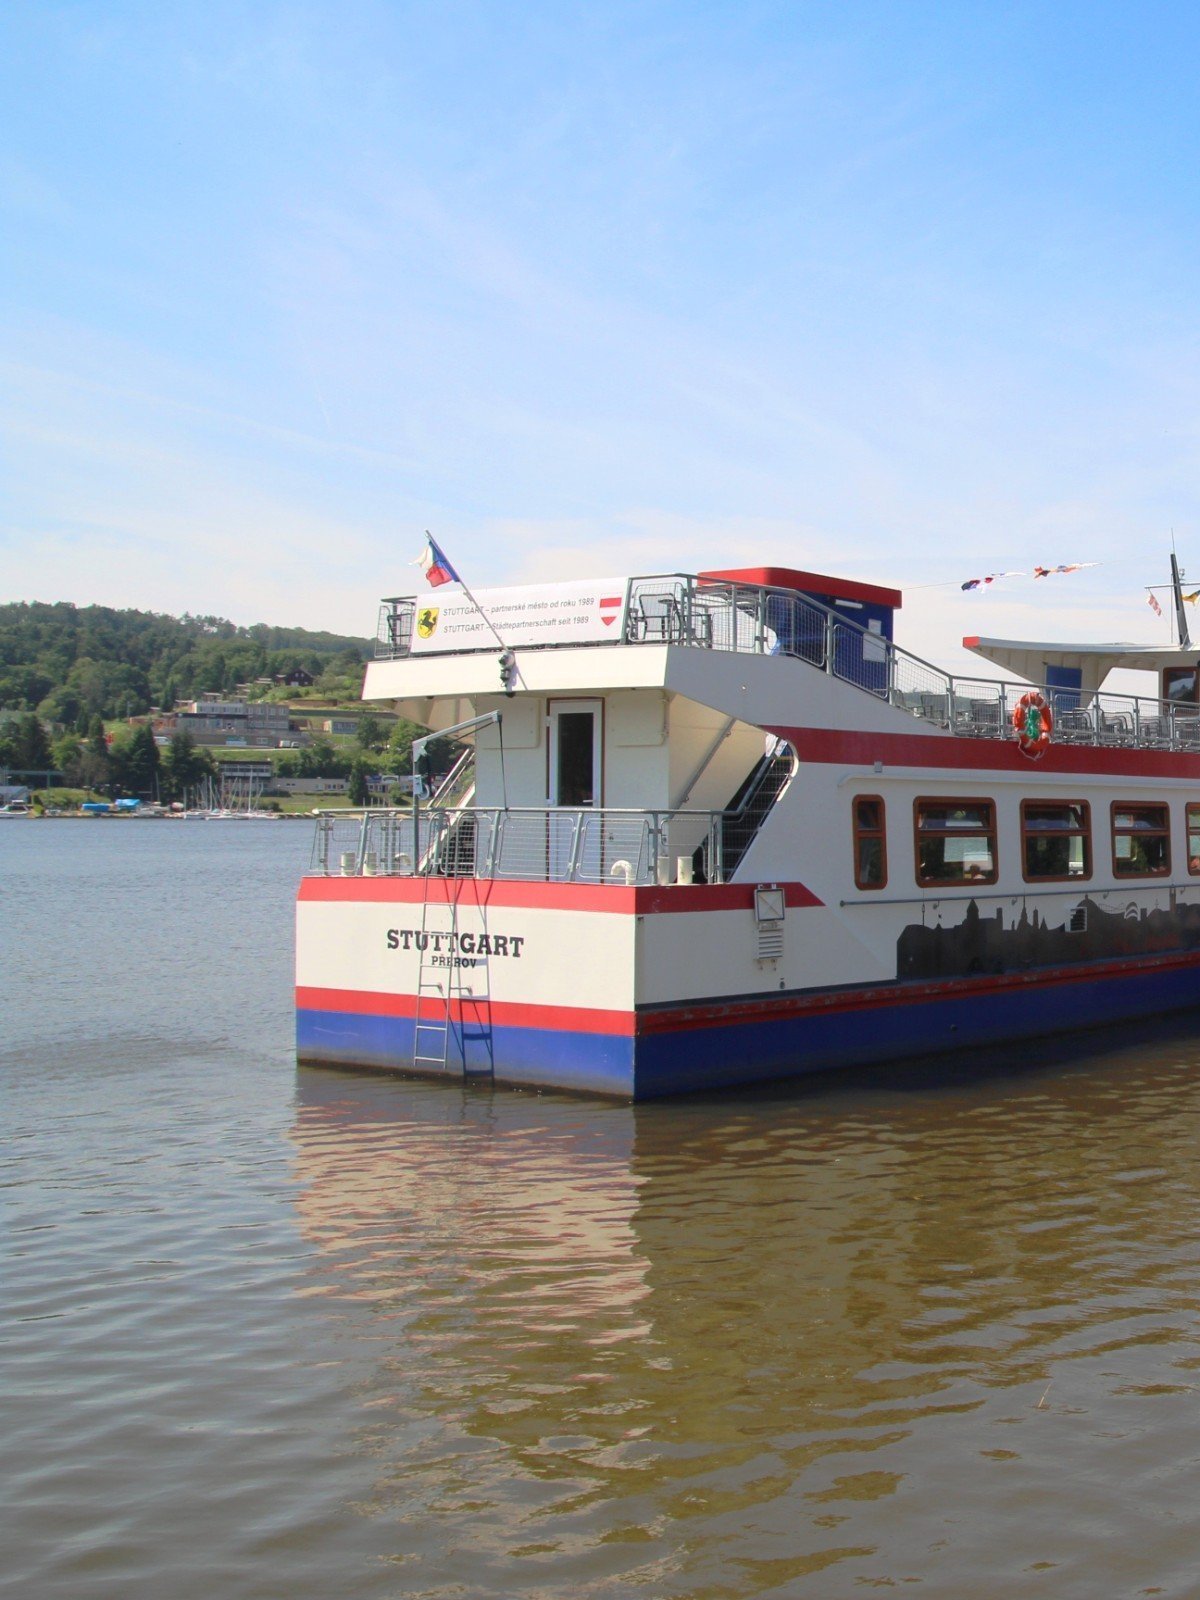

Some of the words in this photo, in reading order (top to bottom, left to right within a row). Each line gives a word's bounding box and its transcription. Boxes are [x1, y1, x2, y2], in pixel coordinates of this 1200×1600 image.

[443, 606, 484, 616] STUTTGART
[491, 603, 526, 614] partnerské
[527, 601, 548, 610] město
[549, 600, 559, 608] od
[560, 599, 576, 608] roku
[578, 597, 595, 606] 1989
[443, 623, 485, 633] STUTTGART
[491, 617, 557, 631] Städtepartnerschaft
[558, 617, 572, 626] seit
[573, 615, 589, 624] 1989
[386, 929, 524, 958] STUTTGART
[431, 953, 477, 969] PŘEROV
